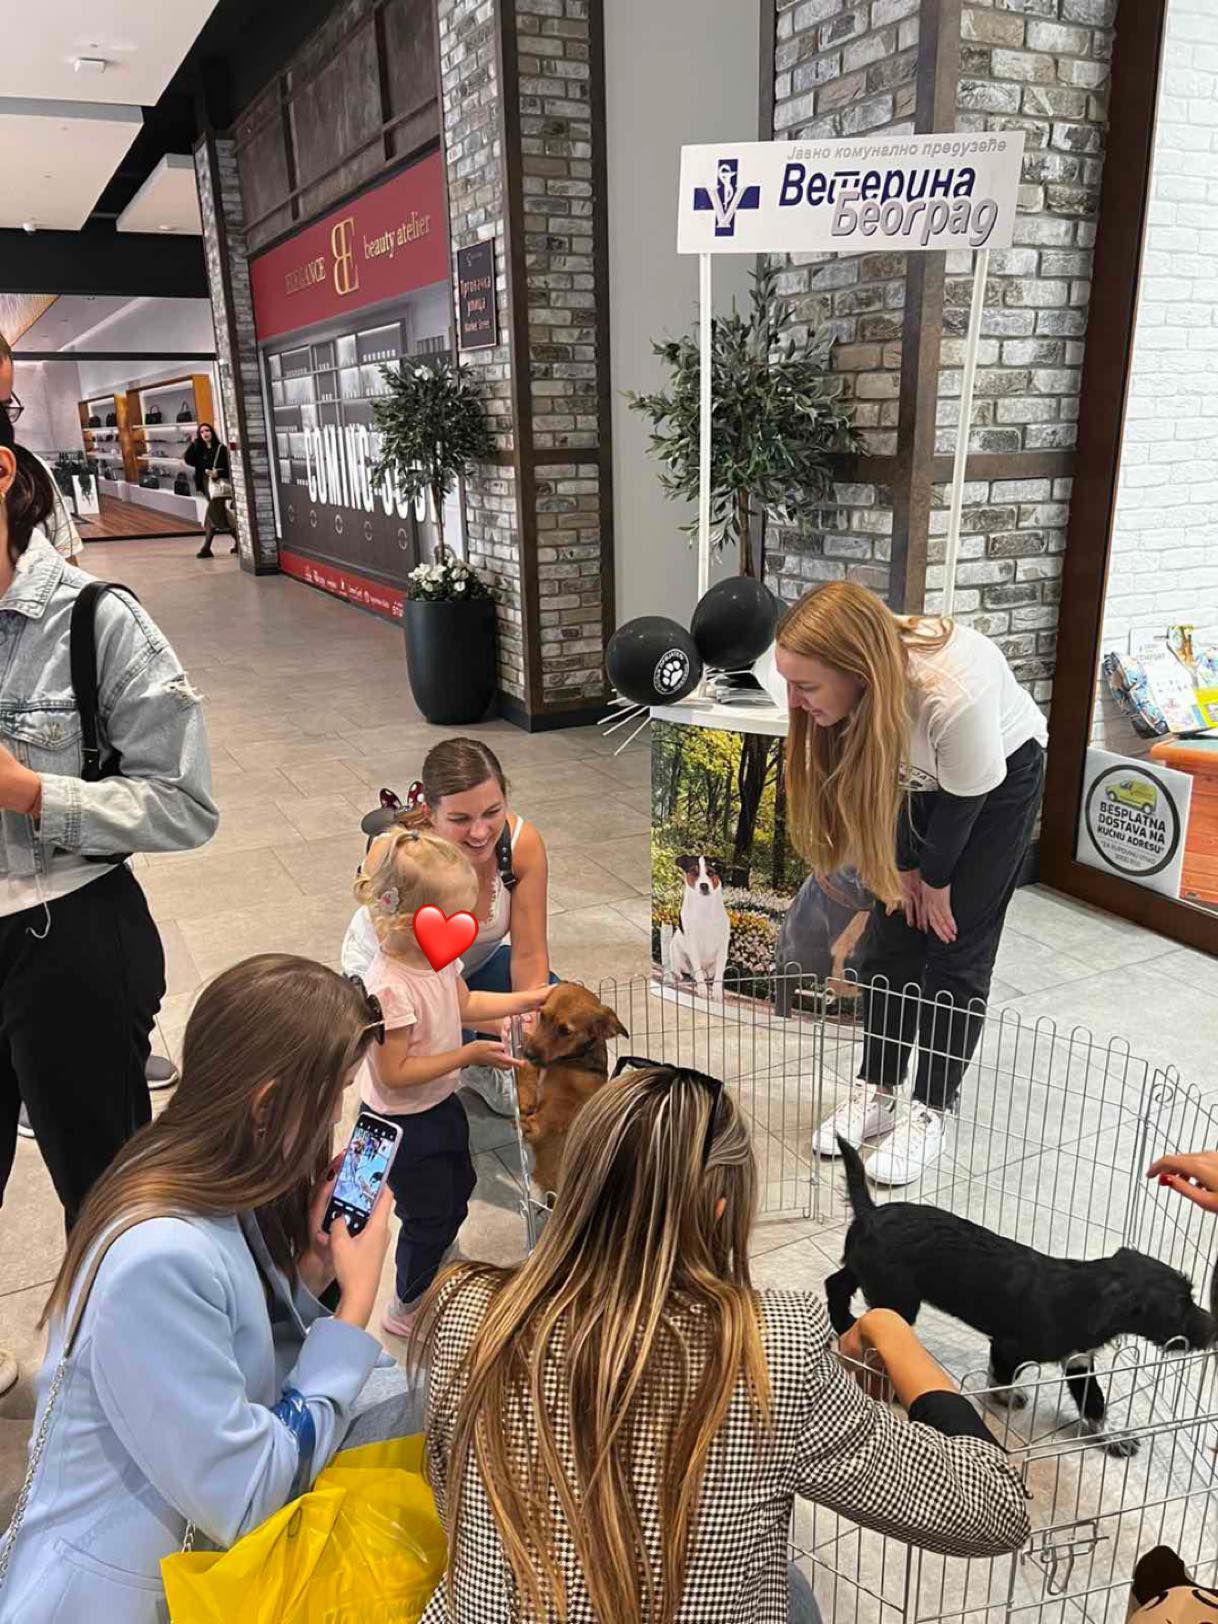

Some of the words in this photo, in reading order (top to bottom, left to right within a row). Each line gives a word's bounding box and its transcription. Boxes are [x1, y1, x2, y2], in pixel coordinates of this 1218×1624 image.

[787, 146, 830, 161] Јавно
[834, 143, 918, 160] комунално
[922, 138, 1007, 158] предузеће
[363, 230, 396, 260] beauty
[397, 211, 431, 246] atelier
[830, 191, 998, 248] Београд
[304, 423, 374, 513] COMING
[1098, 813, 1148, 839] DOSTAVA
[1149, 830, 1166, 845] NA
[1100, 801, 1166, 833] BESPLATNA
